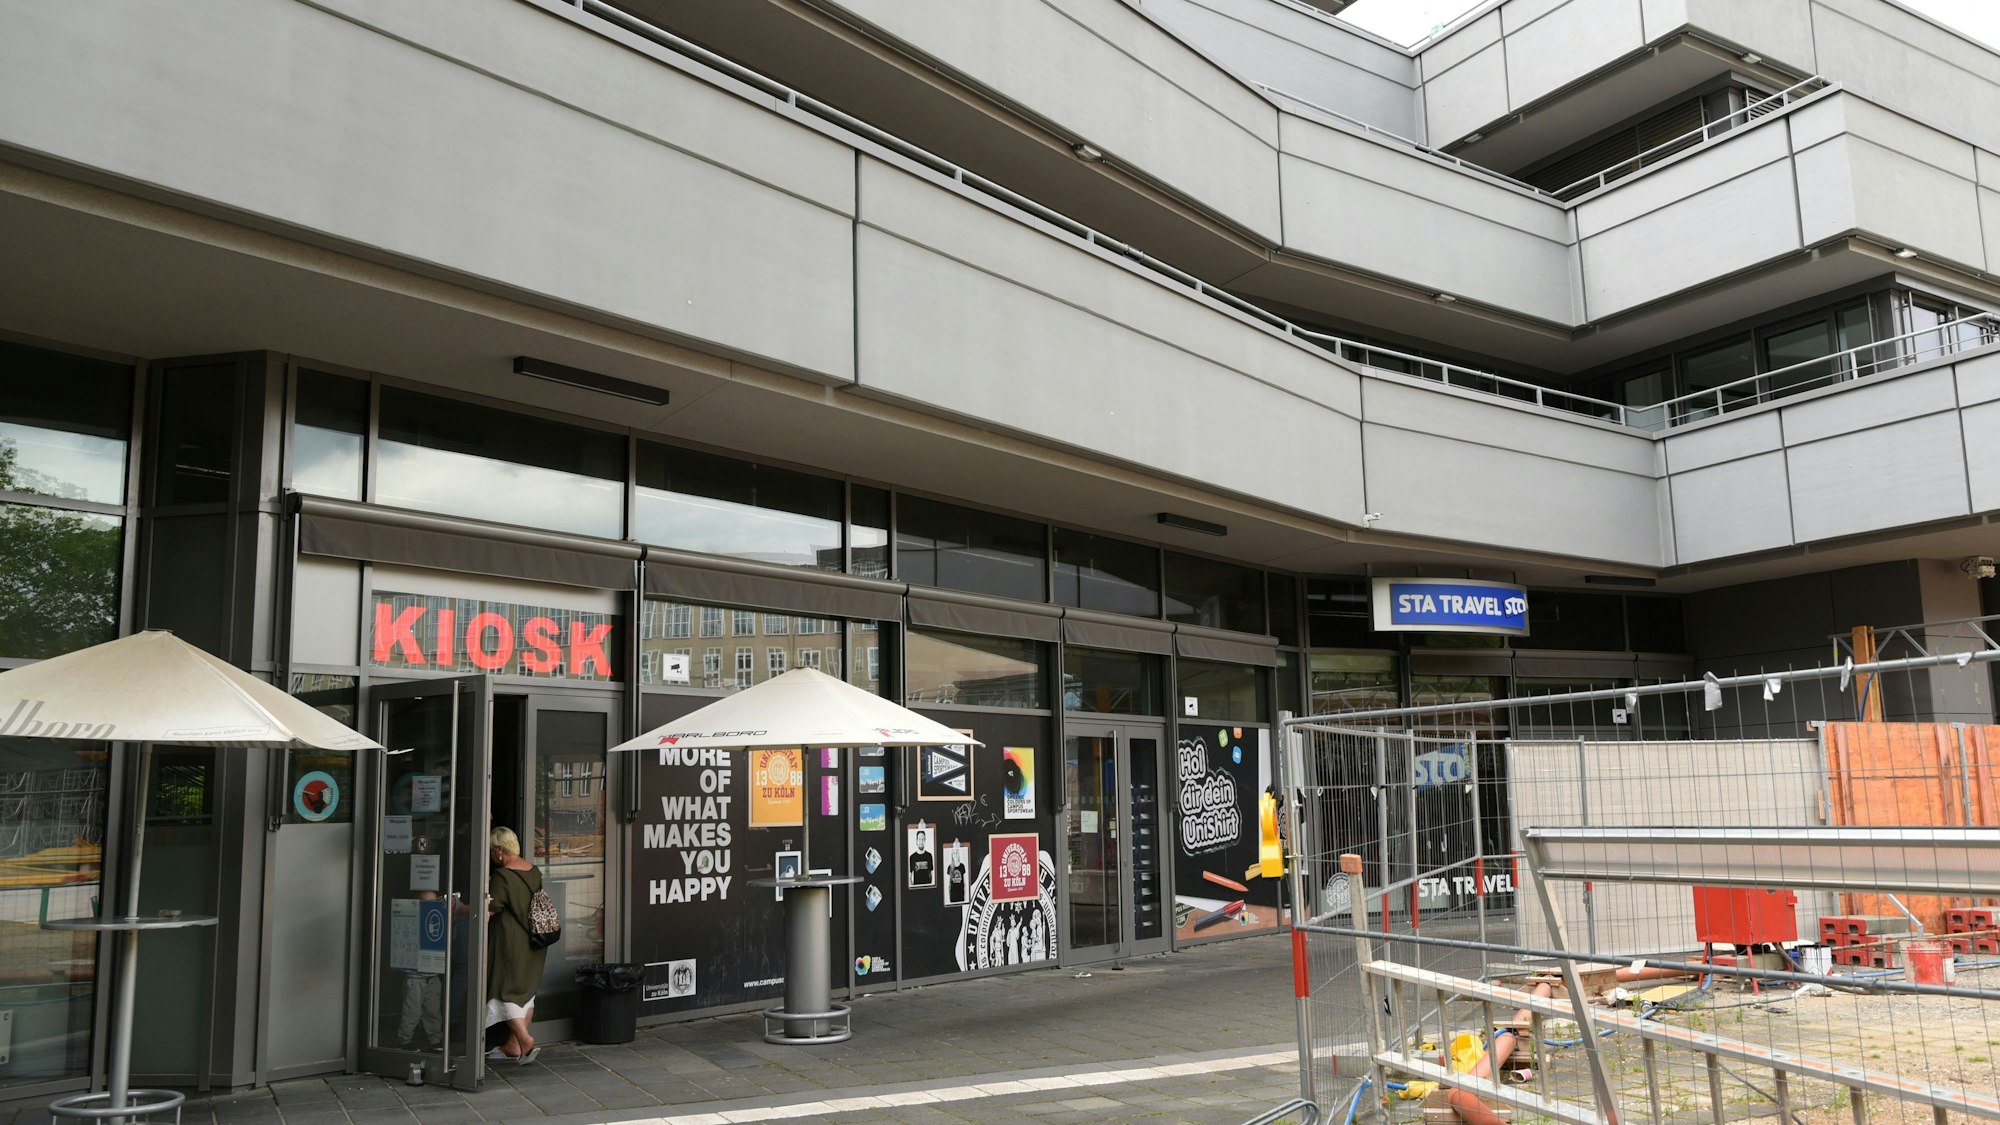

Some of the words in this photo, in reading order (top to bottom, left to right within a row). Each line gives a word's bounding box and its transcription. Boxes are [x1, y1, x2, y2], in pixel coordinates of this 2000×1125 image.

[1399, 594, 1436, 613] STA
[1439, 595, 1502, 616] TRAVEL
[374, 603, 614, 677] KIOSK
[0, 699, 116, 738] lboro
[659, 748, 731, 767] MORE
[1180, 748, 1204, 778] Hol
[700, 769, 732, 794] OF
[756, 770, 768, 786] 13
[774, 786, 795, 798] KÖLN
[1181, 781, 1202, 812] dir
[1203, 776, 1234, 808] dein
[661, 796, 732, 821] WHAT
[643, 822, 732, 849] MAKES
[1183, 810, 1239, 847] UniShirt
[680, 849, 731, 875] YOU
[1001, 843, 1028, 865] UNIVERSITÄT
[1000, 865, 1008, 879] 13
[1022, 864, 1031, 876] 88
[1012, 877, 1026, 887] KÖLN
[650, 876, 732, 905] HAPPY
[1419, 878, 1450, 897] STA
[743, 977, 785, 988] www.campuss
